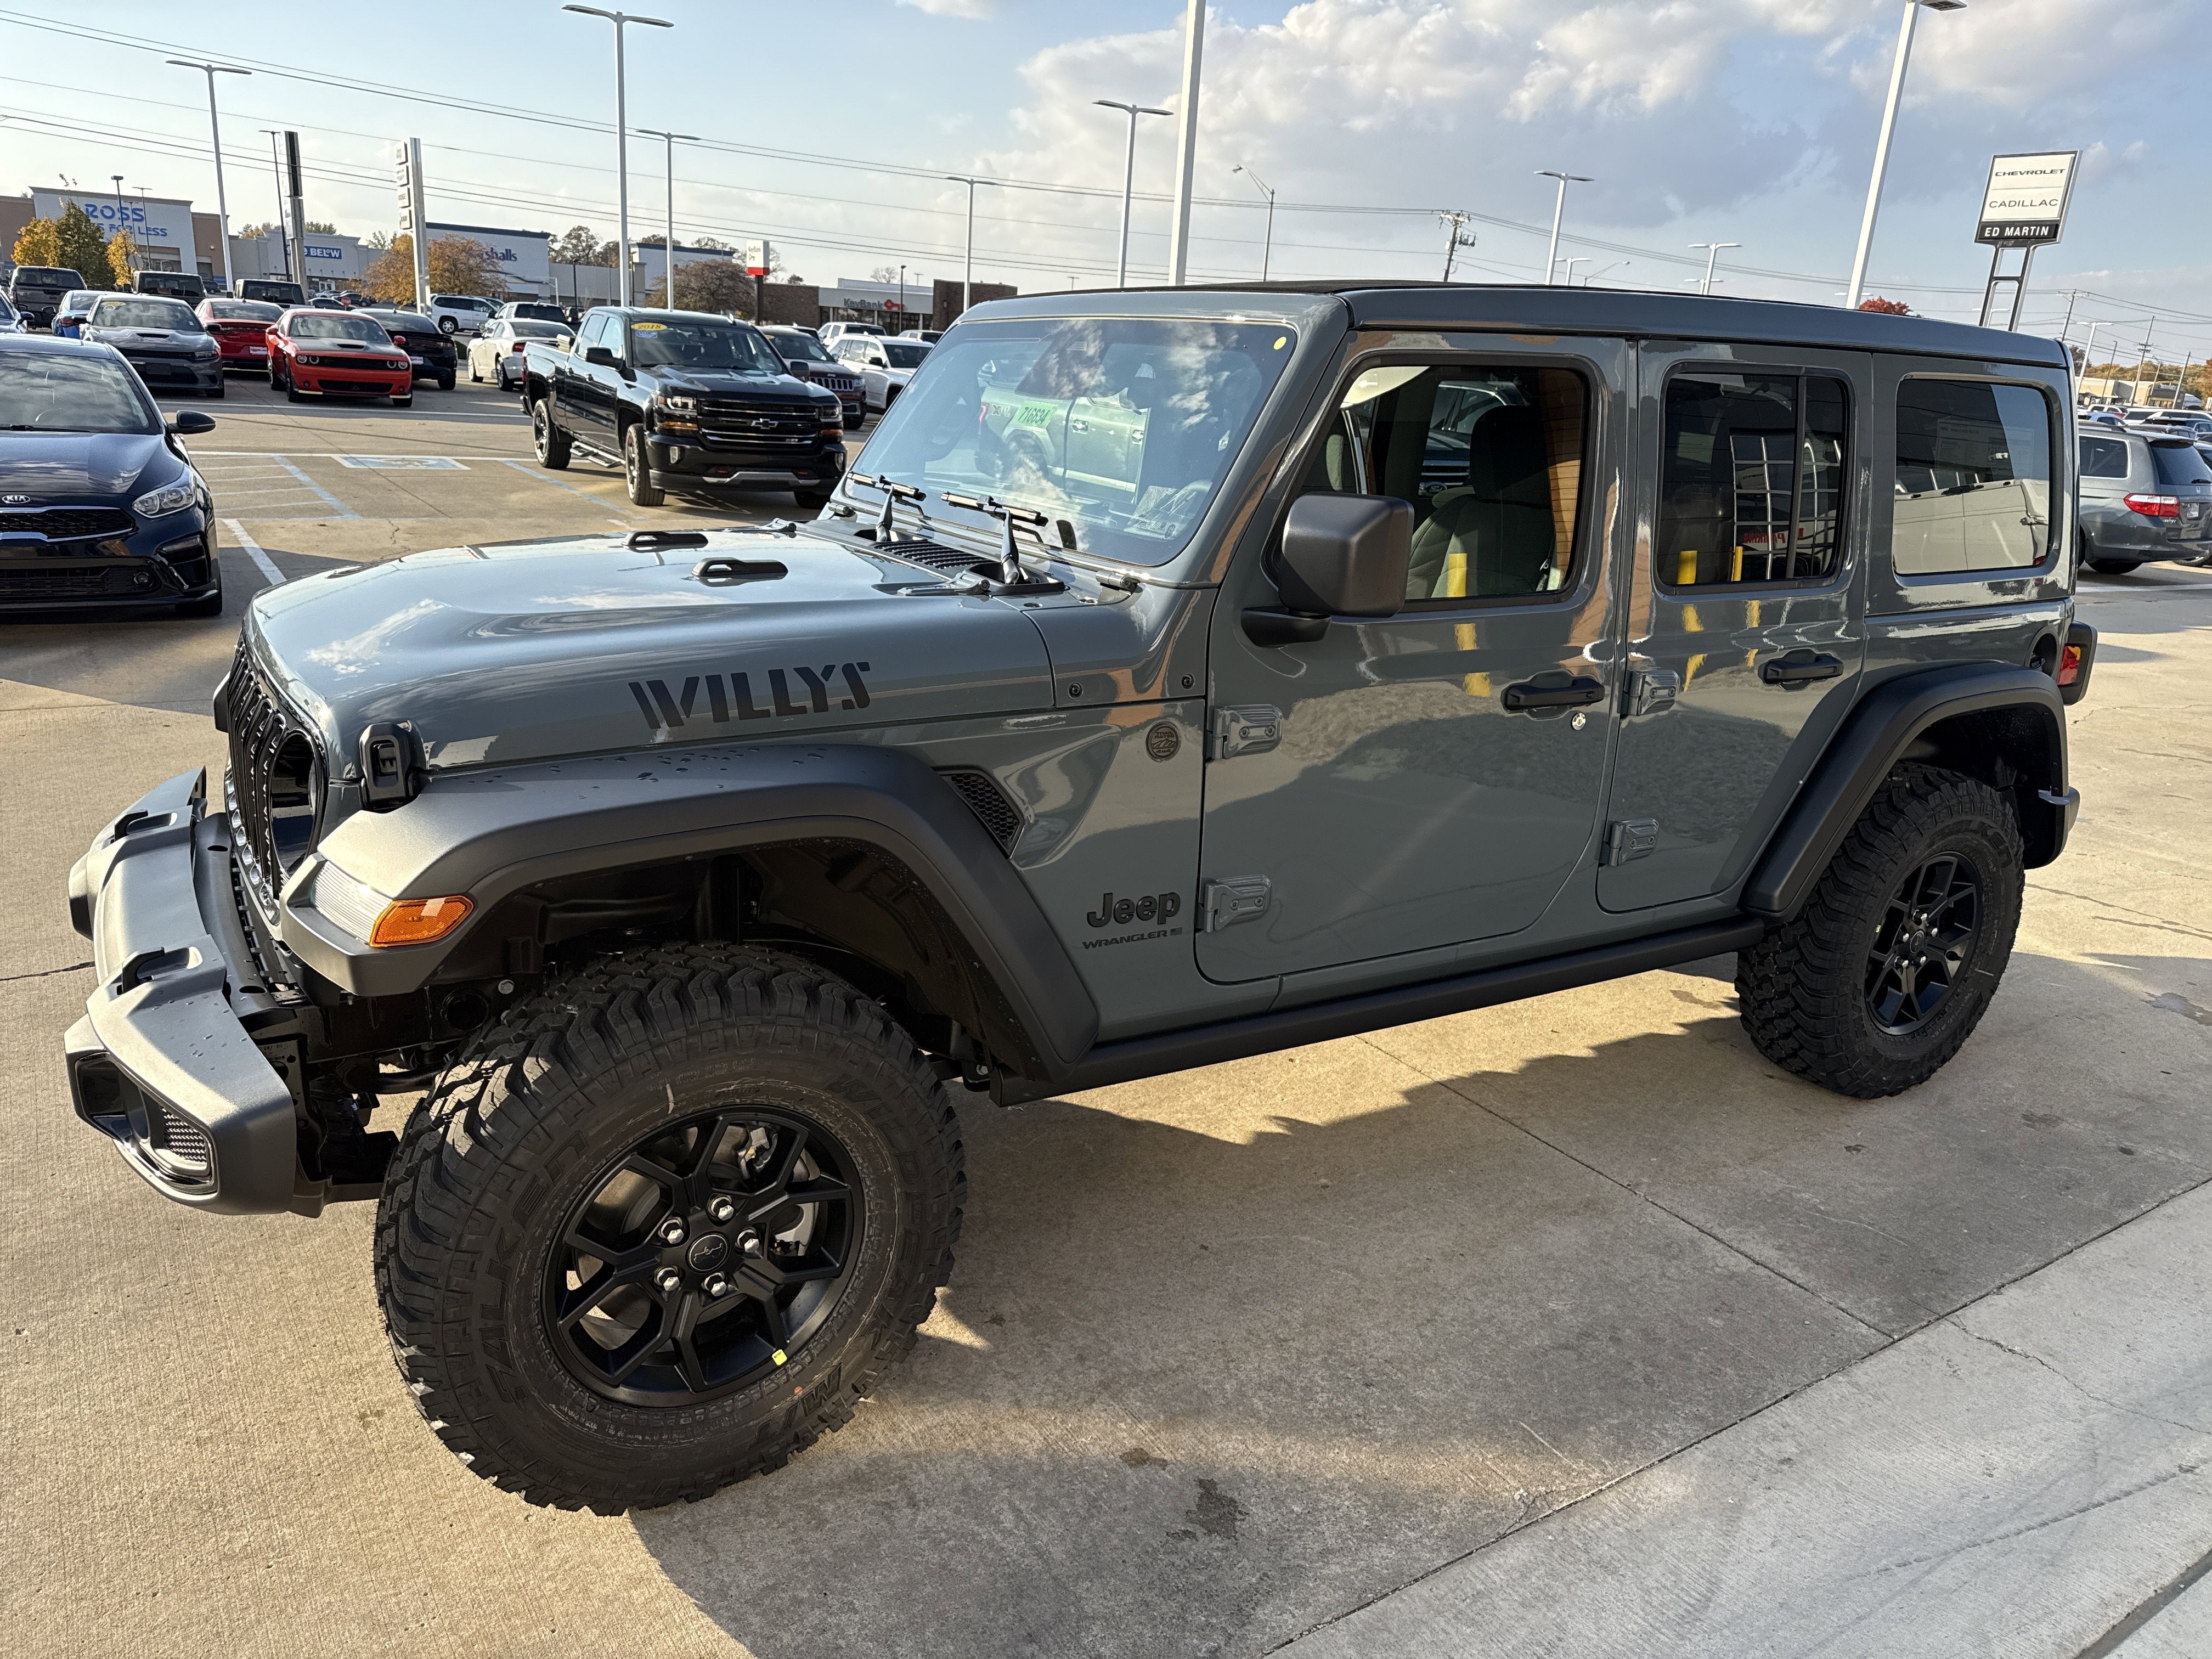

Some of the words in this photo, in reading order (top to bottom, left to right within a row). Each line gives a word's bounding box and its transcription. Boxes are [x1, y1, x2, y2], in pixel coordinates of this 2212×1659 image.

[1989, 199, 2058, 208] CADILLAC
[84, 204, 144, 222] ROSS
[1984, 227, 2000, 237] ED
[2004, 226, 2049, 236] MARTIN
[310, 248, 340, 258] BELOW
[844, 298, 883, 310] KeyBank
[1018, 407, 1051, 425] 716634
[628, 662, 871, 729] WILLYS
[1087, 892, 1181, 928] Jeep
[1082, 929, 1167, 950] WRANGLER
[823, 1073, 923, 1352] WILDPEAK
[478, 1129, 591, 1410] FALKEN
